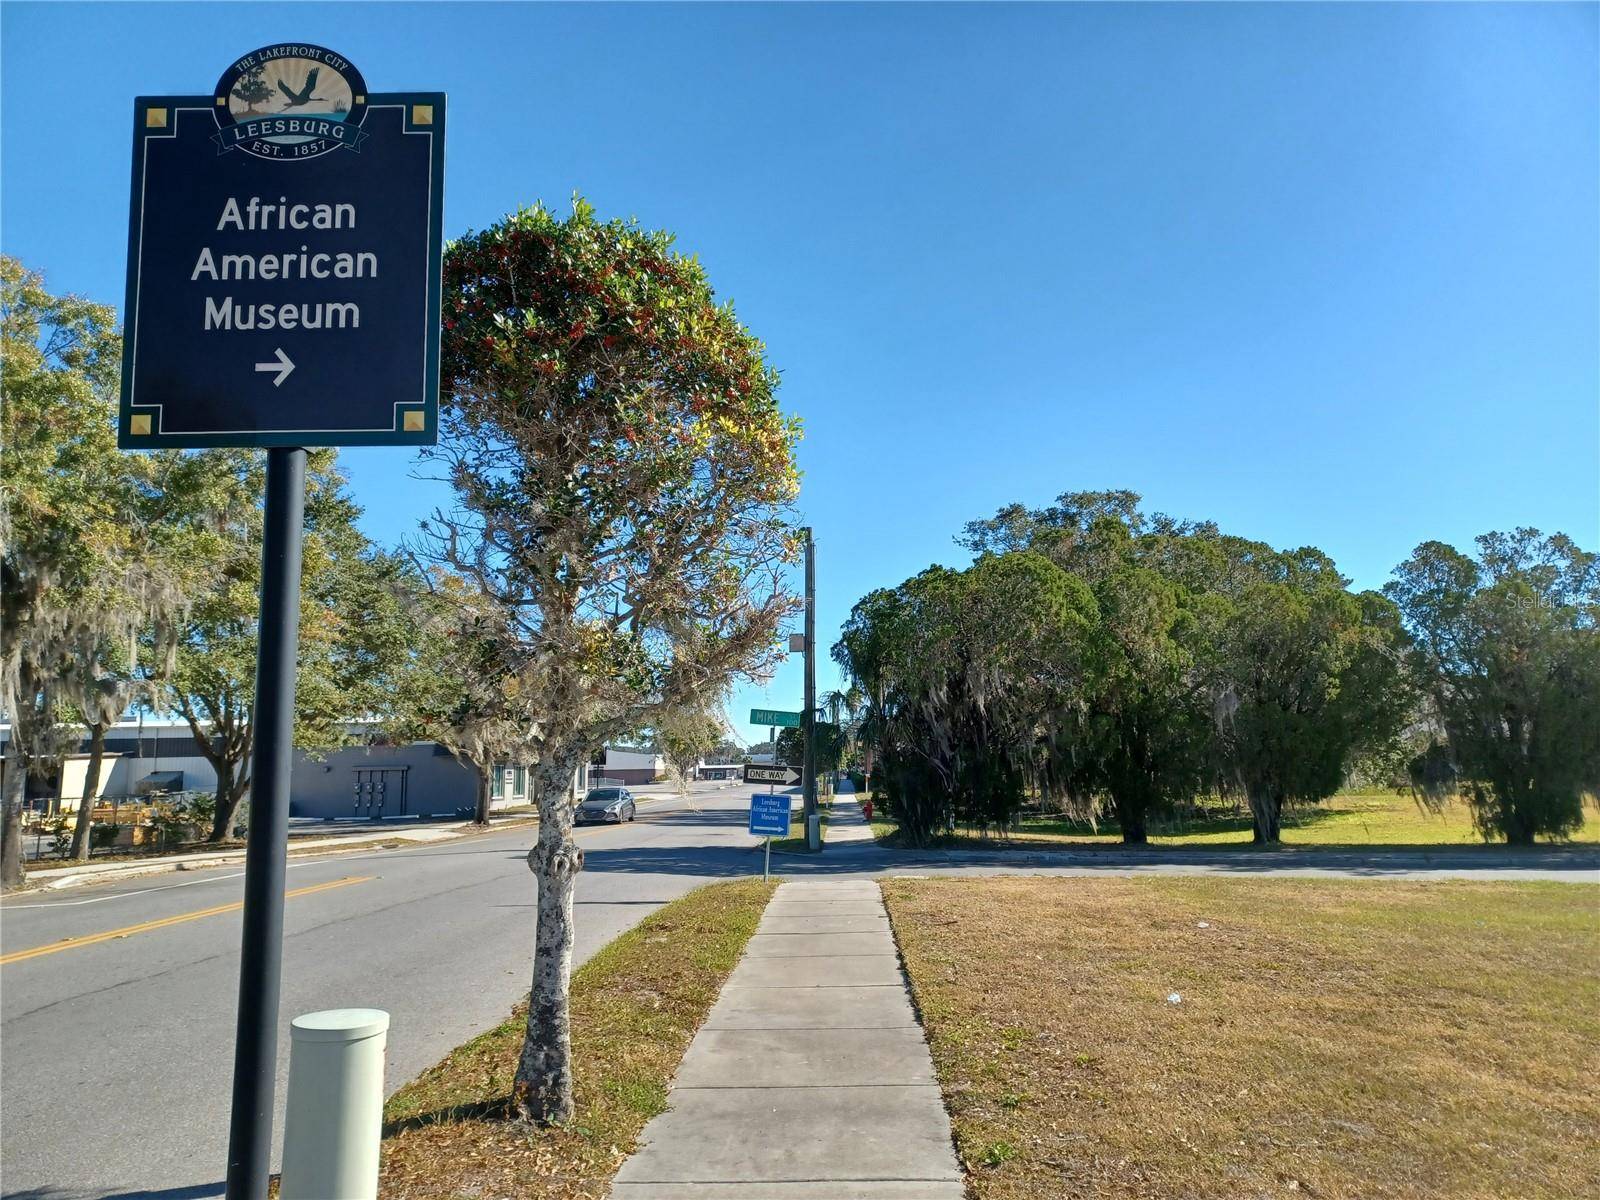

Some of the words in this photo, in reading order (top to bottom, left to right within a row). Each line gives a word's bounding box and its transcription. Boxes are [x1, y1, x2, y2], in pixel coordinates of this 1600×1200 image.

[235, 56, 256, 72] THE
[258, 46, 322, 61] LAKEFRONT
[324, 53, 350, 71] CITY
[234, 120, 345, 140] LEESBURG
[251, 141, 284, 156] EST.
[294, 140, 327, 156] 1857
[216, 196, 356, 231] African
[190, 245, 378, 281] American
[204, 297, 360, 331] Museum
[756, 711, 779, 724] MIKE
[749, 769, 766, 778] ONE
[768, 771, 786, 779] WAY
